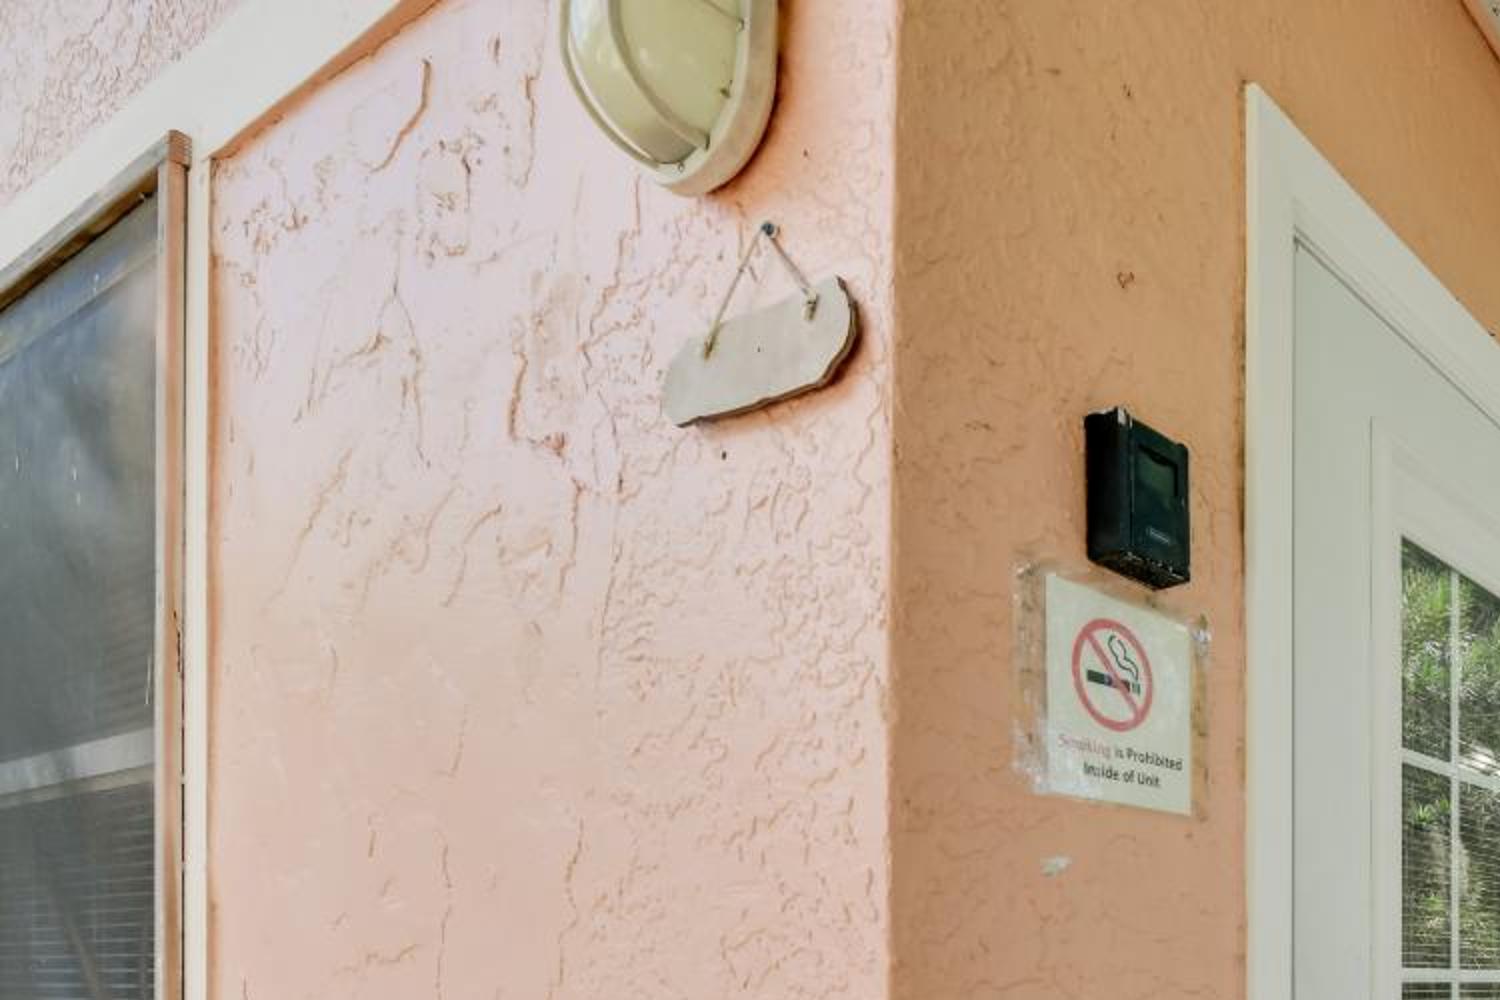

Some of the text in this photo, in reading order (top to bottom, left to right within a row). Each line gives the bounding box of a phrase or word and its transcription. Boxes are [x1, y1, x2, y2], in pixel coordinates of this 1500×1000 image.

[1126, 748, 1183, 771] Prohibited
[1083, 762, 1160, 787] Inside of Unit
